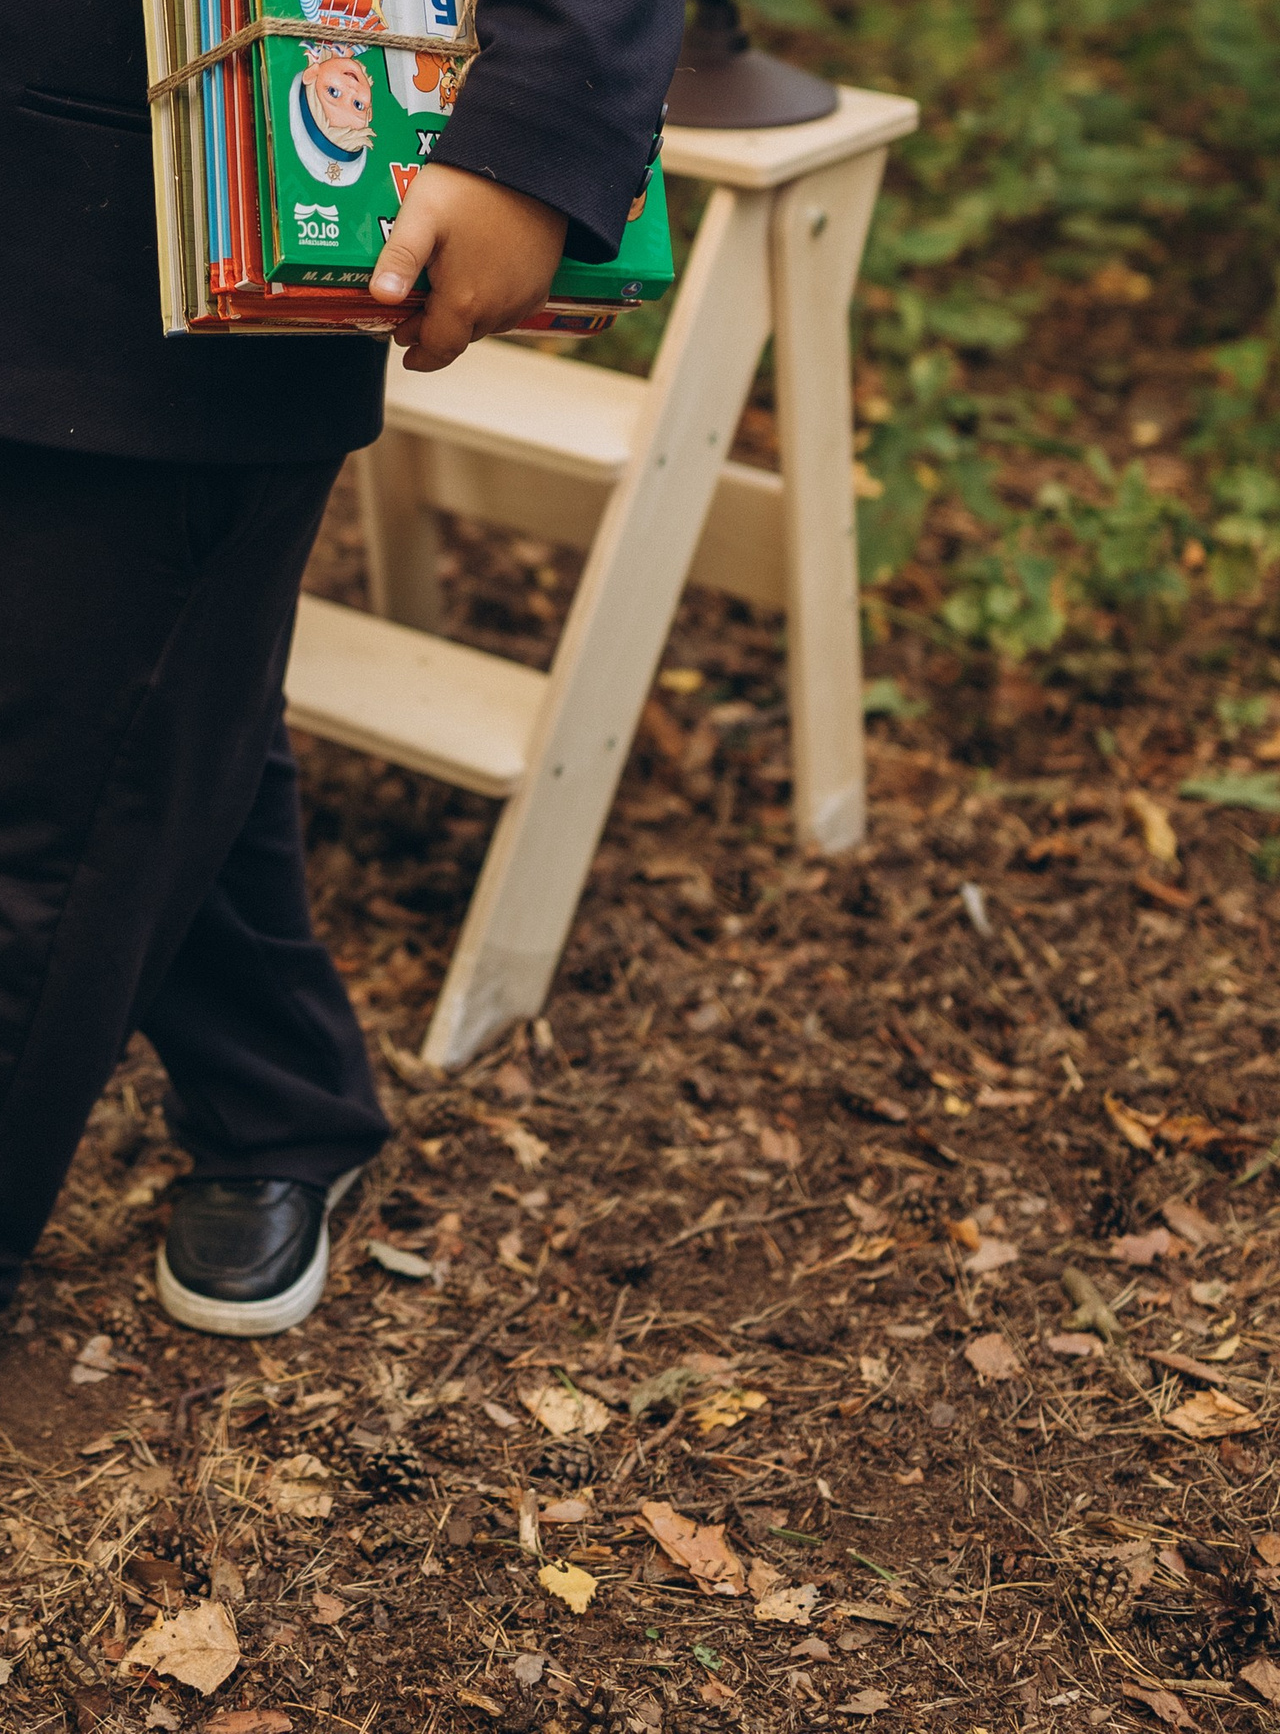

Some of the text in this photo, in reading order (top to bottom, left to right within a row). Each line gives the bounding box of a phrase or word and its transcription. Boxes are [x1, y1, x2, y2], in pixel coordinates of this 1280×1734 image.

[297, 220, 340, 239] ФГОС
[302, 271, 318, 281] М.
[320, 272, 335, 281] А.
